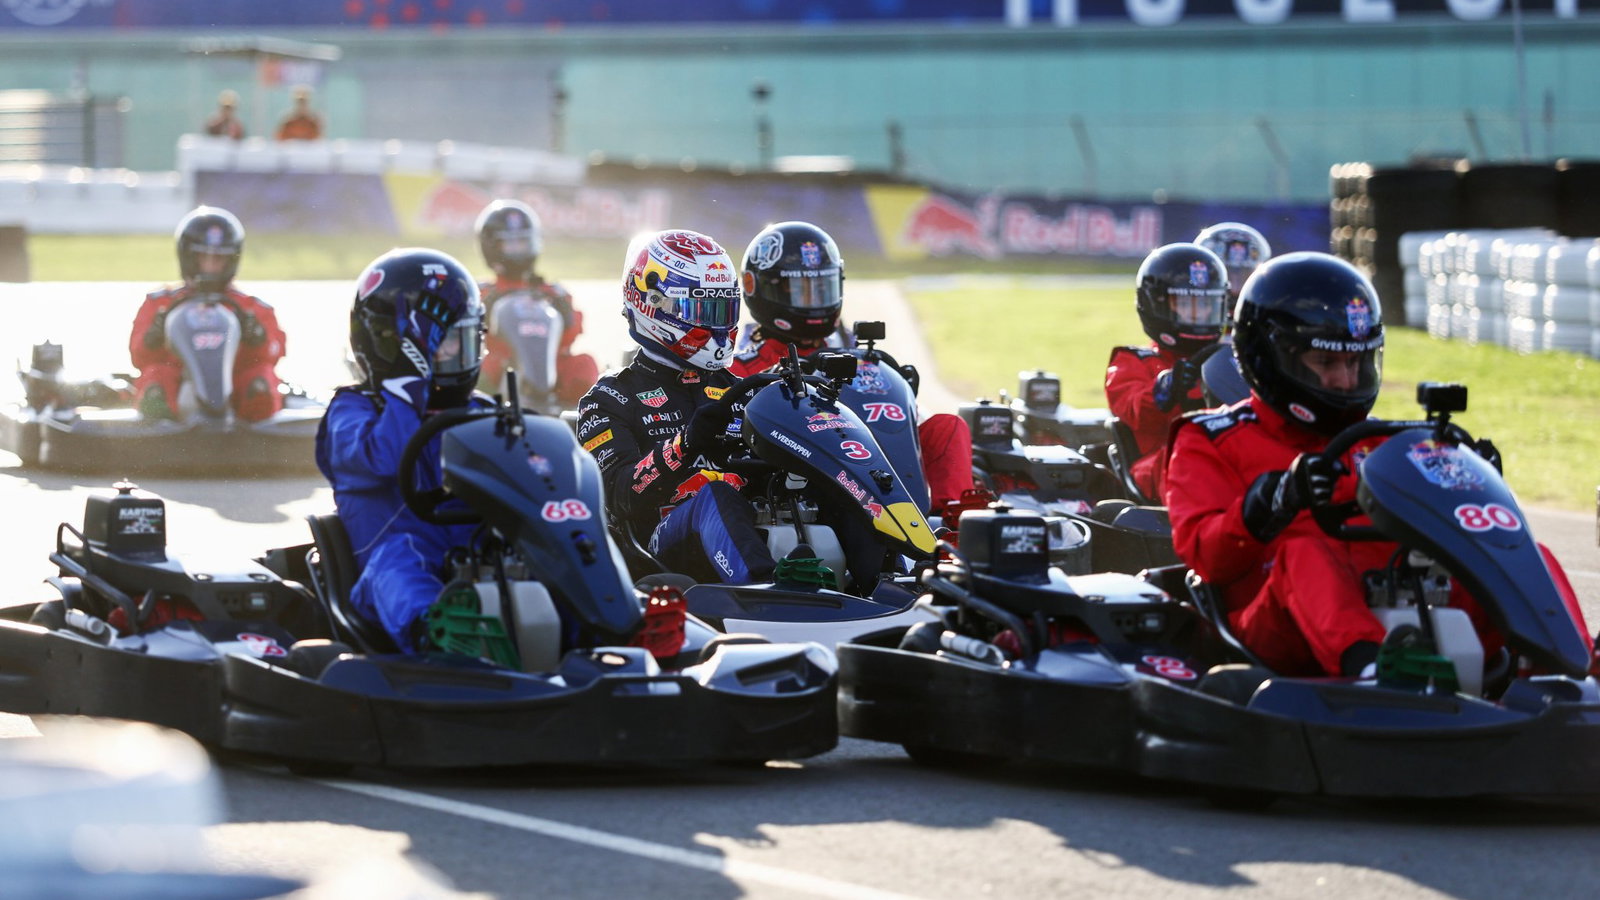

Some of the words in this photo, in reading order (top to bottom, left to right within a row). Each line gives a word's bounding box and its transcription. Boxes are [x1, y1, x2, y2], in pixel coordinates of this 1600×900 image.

[803, 270, 819, 278] YOU
[692, 288, 741, 298] ORACLE
[1311, 338, 1342, 351] GIVES
[1345, 342, 1365, 352] YOU
[641, 389, 666, 399] TAG
[643, 397, 669, 408] HEUER
[641, 412, 671, 425] Mobil
[862, 402, 907, 423] 78
[770, 429, 812, 459] M.VERSTAPPEN
[840, 440, 873, 460] 3
[119, 507, 163, 517] KARTING
[541, 498, 592, 523] 68
[1454, 503, 1522, 532] 80
[1001, 525, 1046, 535] KARTING
[1141, 655, 1198, 681] 80
